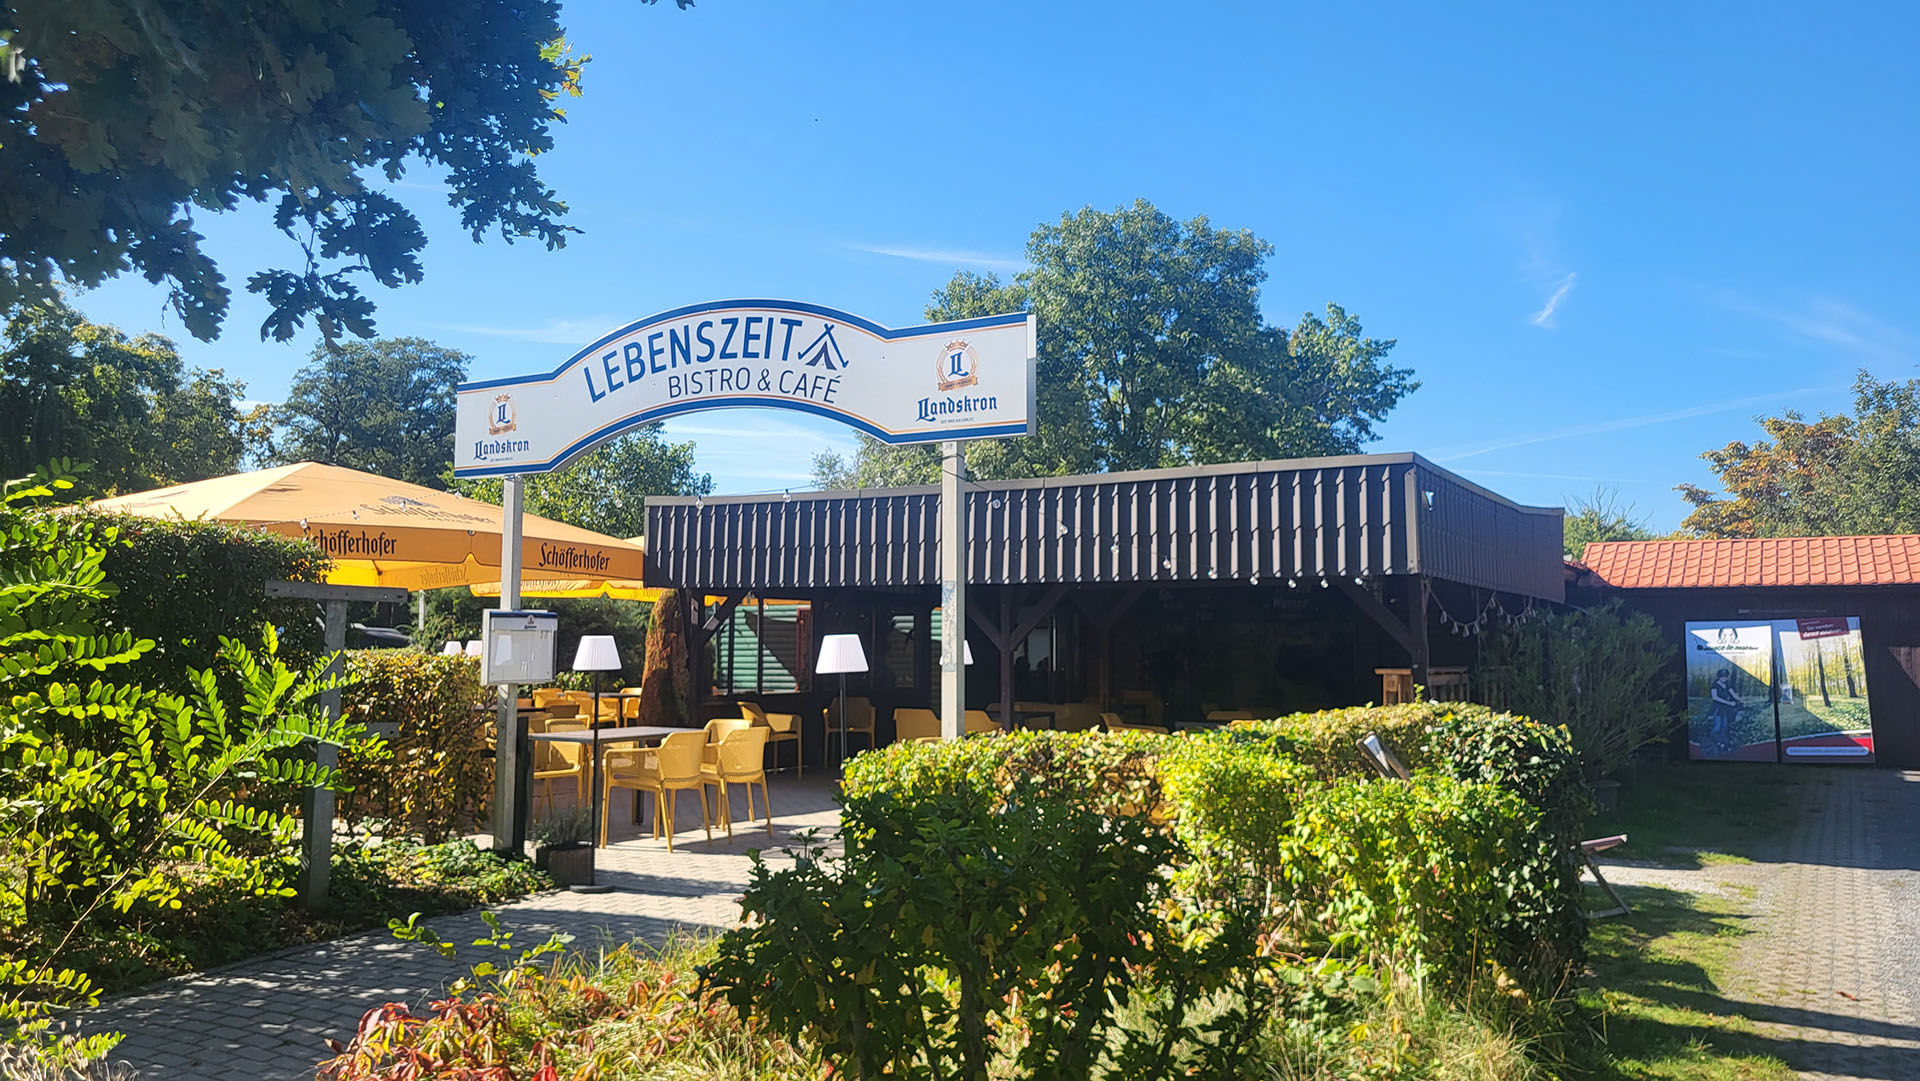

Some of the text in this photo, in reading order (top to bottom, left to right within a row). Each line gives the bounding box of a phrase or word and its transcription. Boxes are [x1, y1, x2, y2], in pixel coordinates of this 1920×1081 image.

[584, 316, 803, 403] LEBENSZEIT
[668, 367, 843, 404] BISTRO & CAFÉ
[915, 394, 998, 422] Landskron
[473, 438, 530, 461] Landskron
[539, 542, 611, 571] Schöfferhofer
